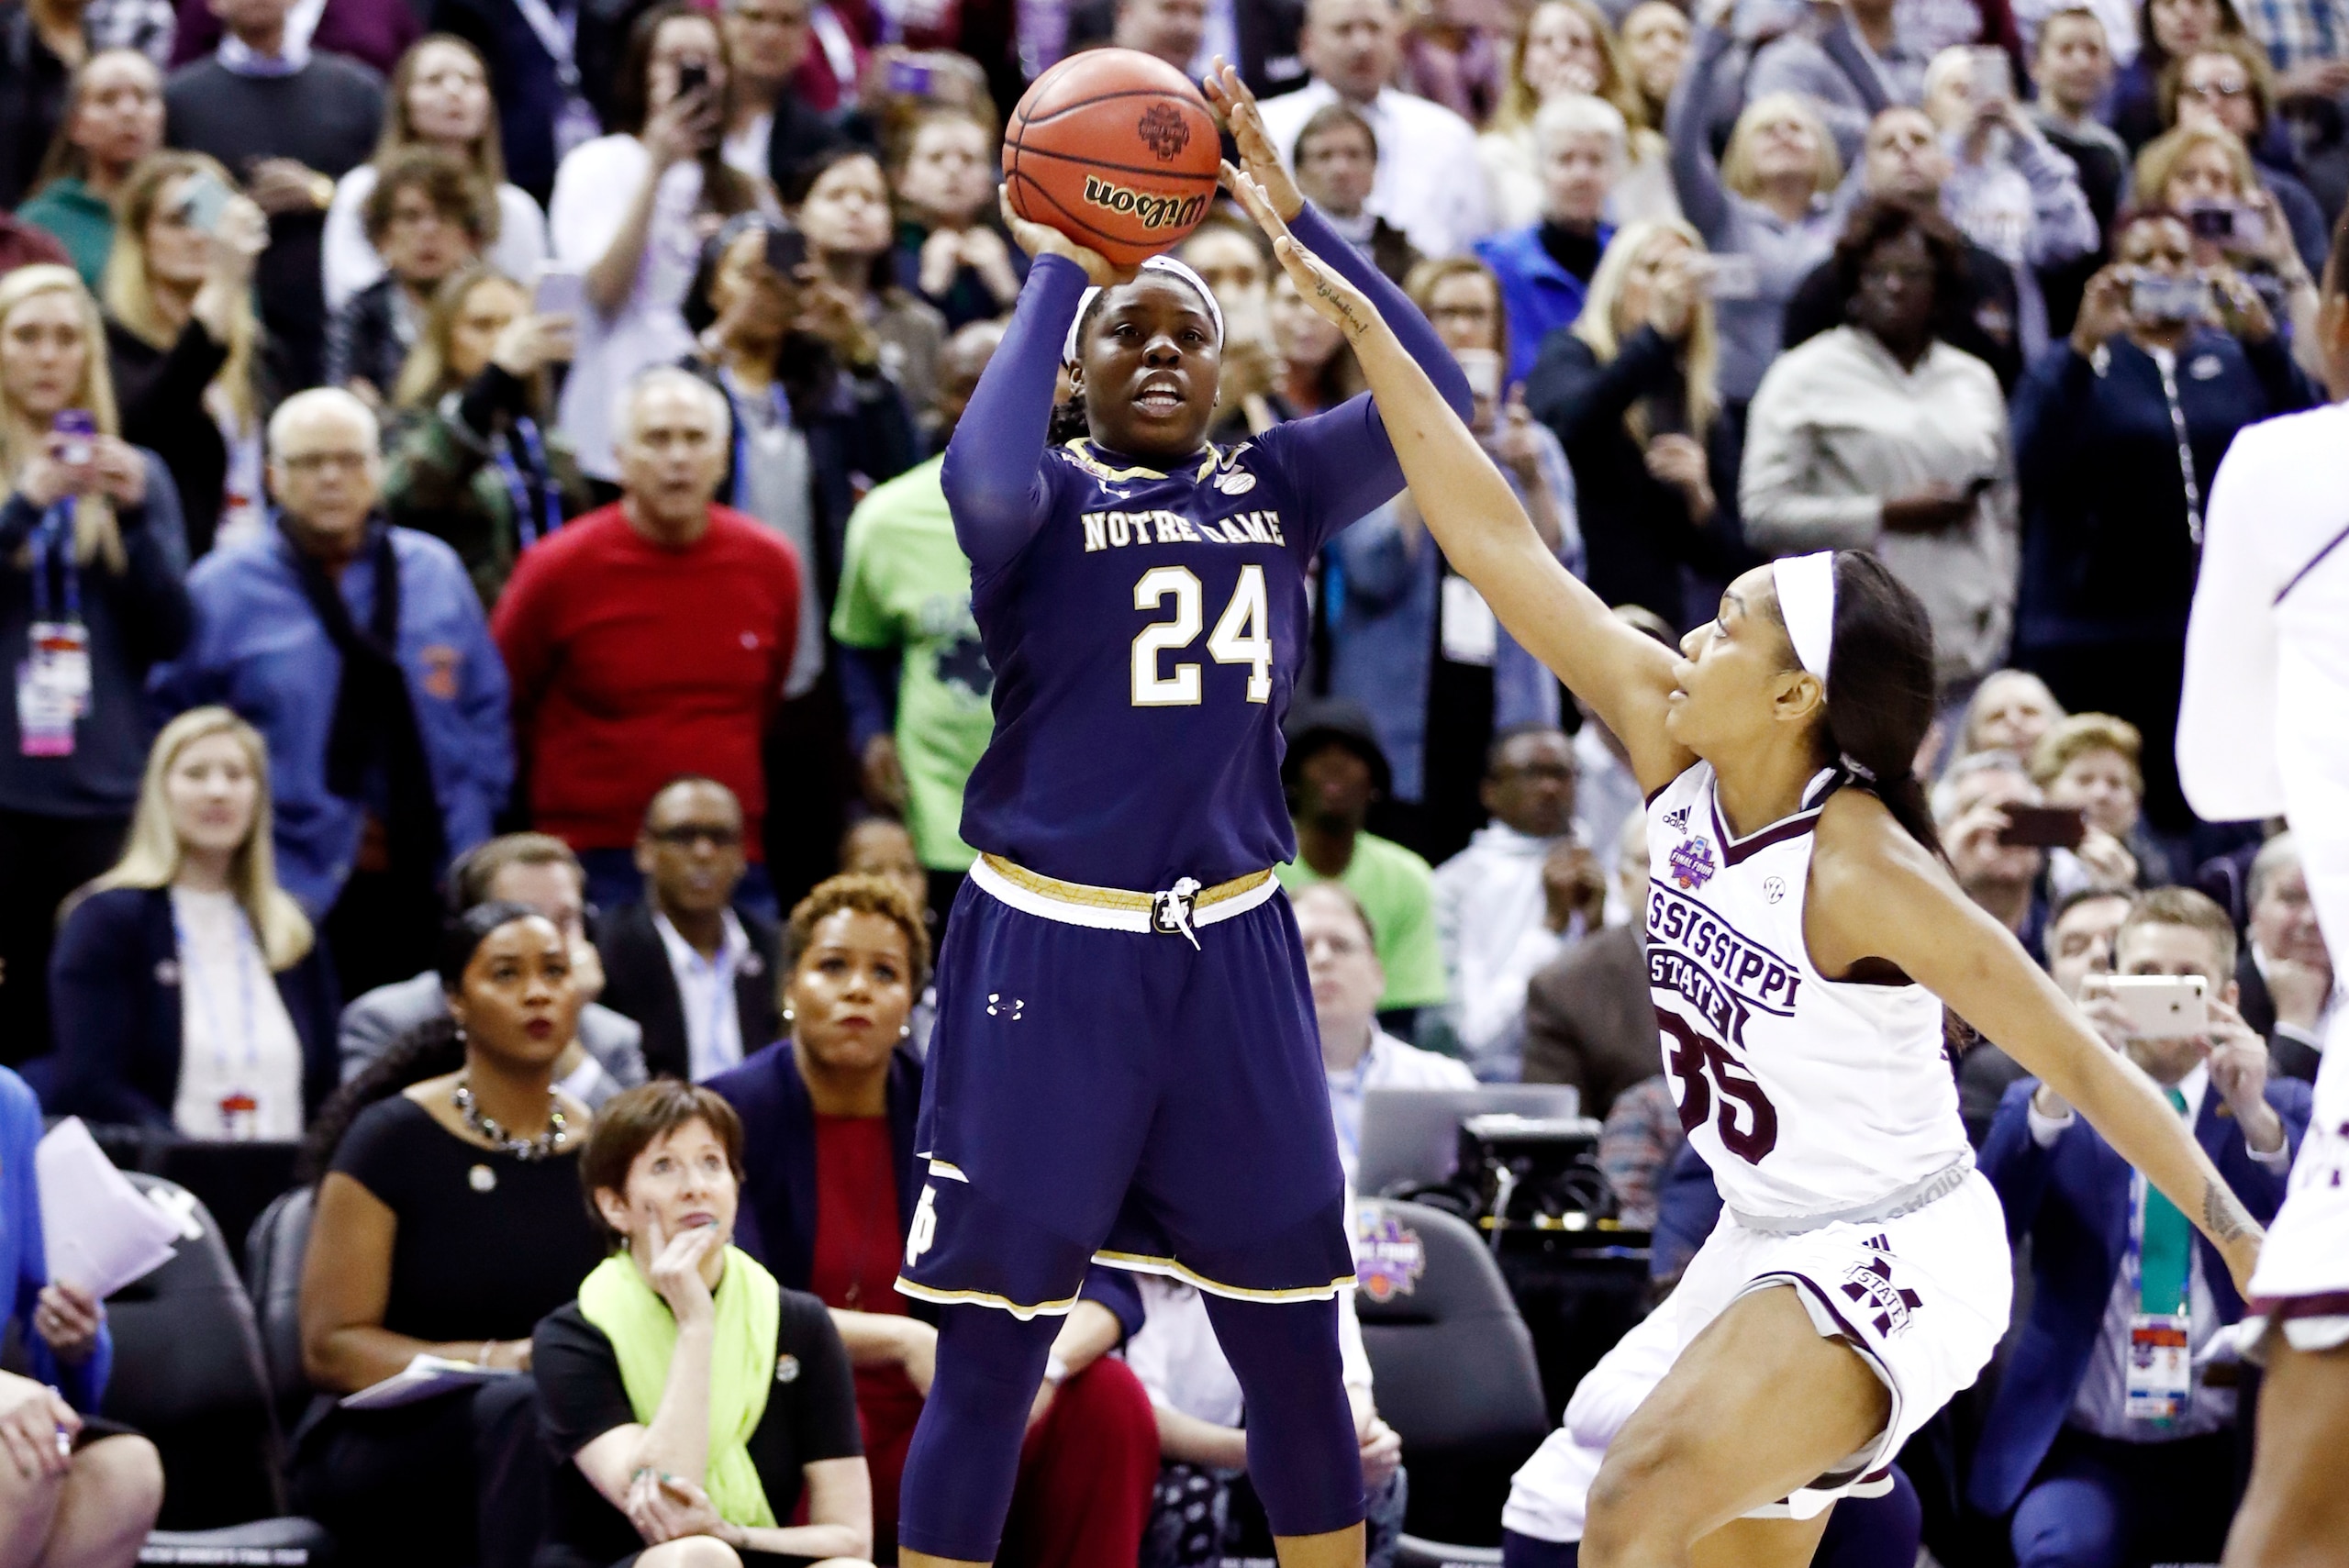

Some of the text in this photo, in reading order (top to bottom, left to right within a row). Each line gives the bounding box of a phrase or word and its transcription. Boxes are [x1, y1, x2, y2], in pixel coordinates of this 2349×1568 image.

[1084, 174, 1207, 228] Wilson
[1081, 509, 1202, 552] NOTRE
[1130, 564, 1273, 706] 24
[1671, 851, 1713, 877] FINAL FOUR
[1648, 887, 1801, 1006] SSISSIPPI
[1651, 954, 1723, 1029] STATE
[1654, 1004, 1778, 1165] 35
[1857, 1272, 1905, 1324] STATE
